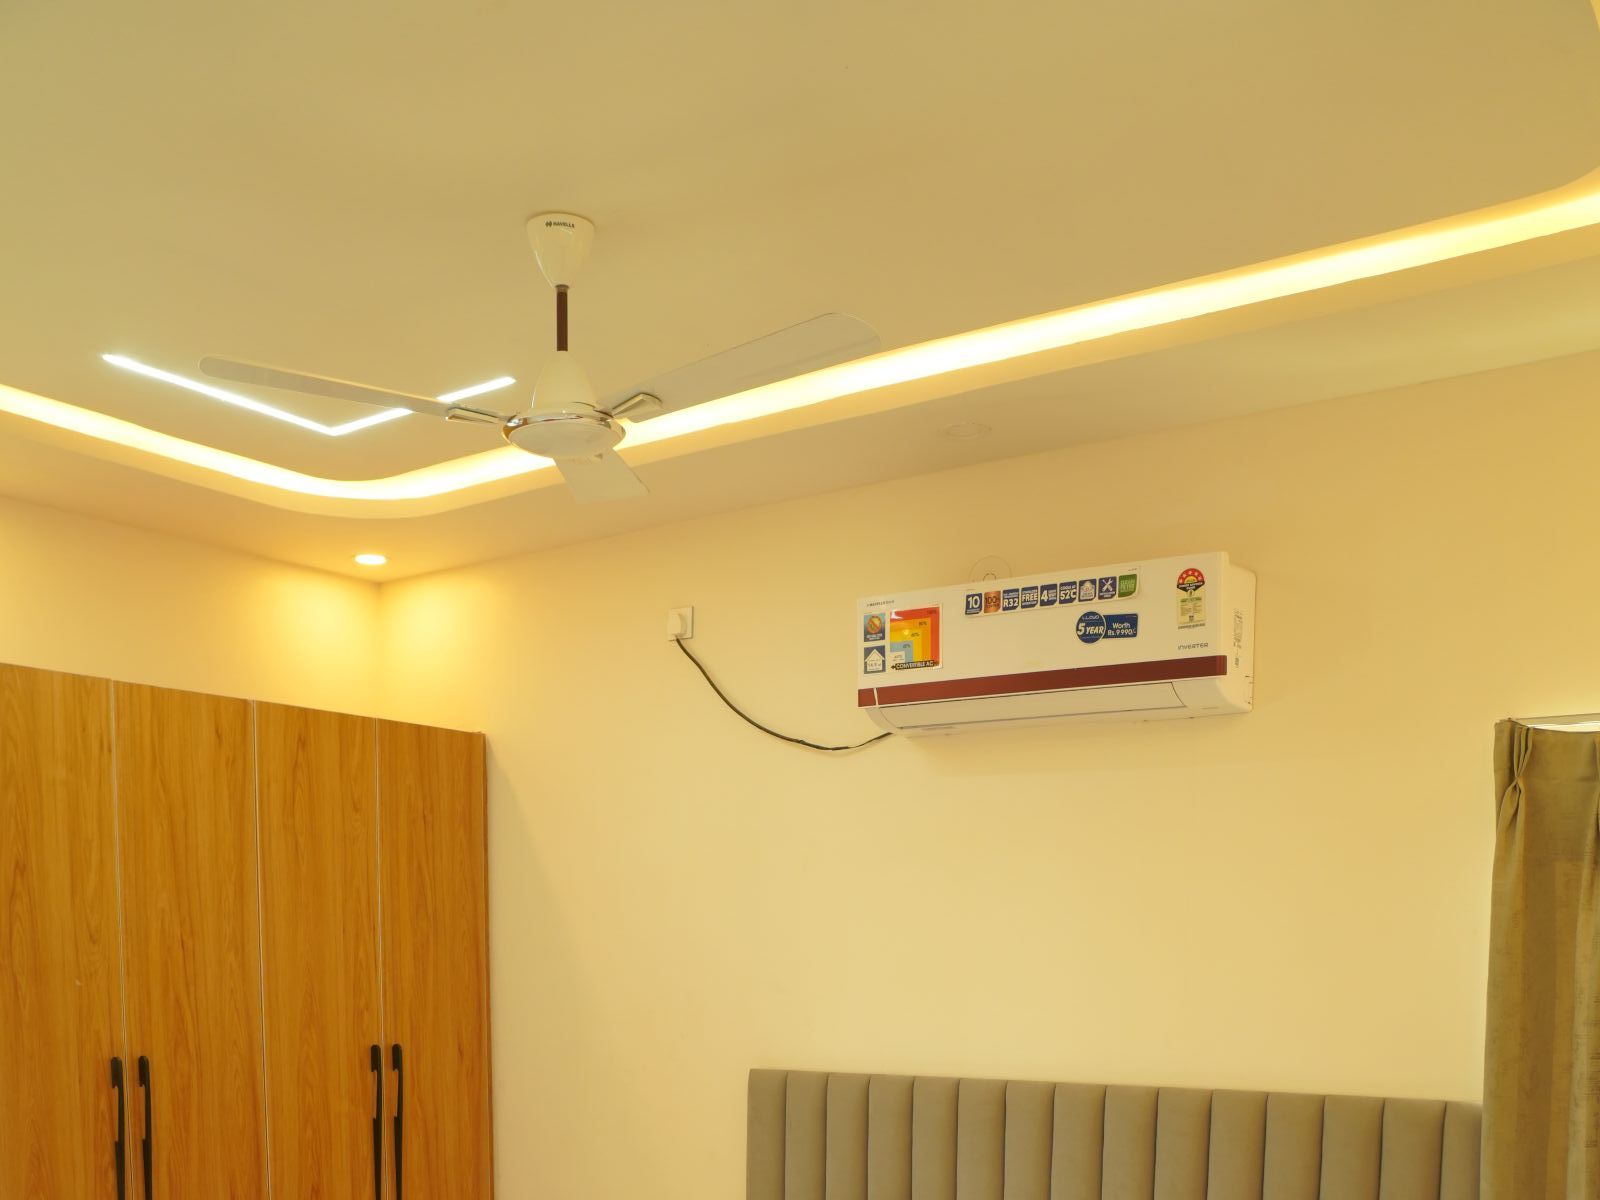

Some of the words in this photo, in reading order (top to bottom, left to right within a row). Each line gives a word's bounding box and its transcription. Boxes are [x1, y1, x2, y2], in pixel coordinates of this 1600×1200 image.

[1022, 592, 1038, 602] FREE
[1040, 590, 1049, 602] 4
[967, 596, 980, 609] 10
[1003, 598, 1019, 608] R32
[1077, 622, 1086, 636] 5
[1086, 626, 1104, 635] YEAR
[1178, 642, 1209, 650] INVERTER
